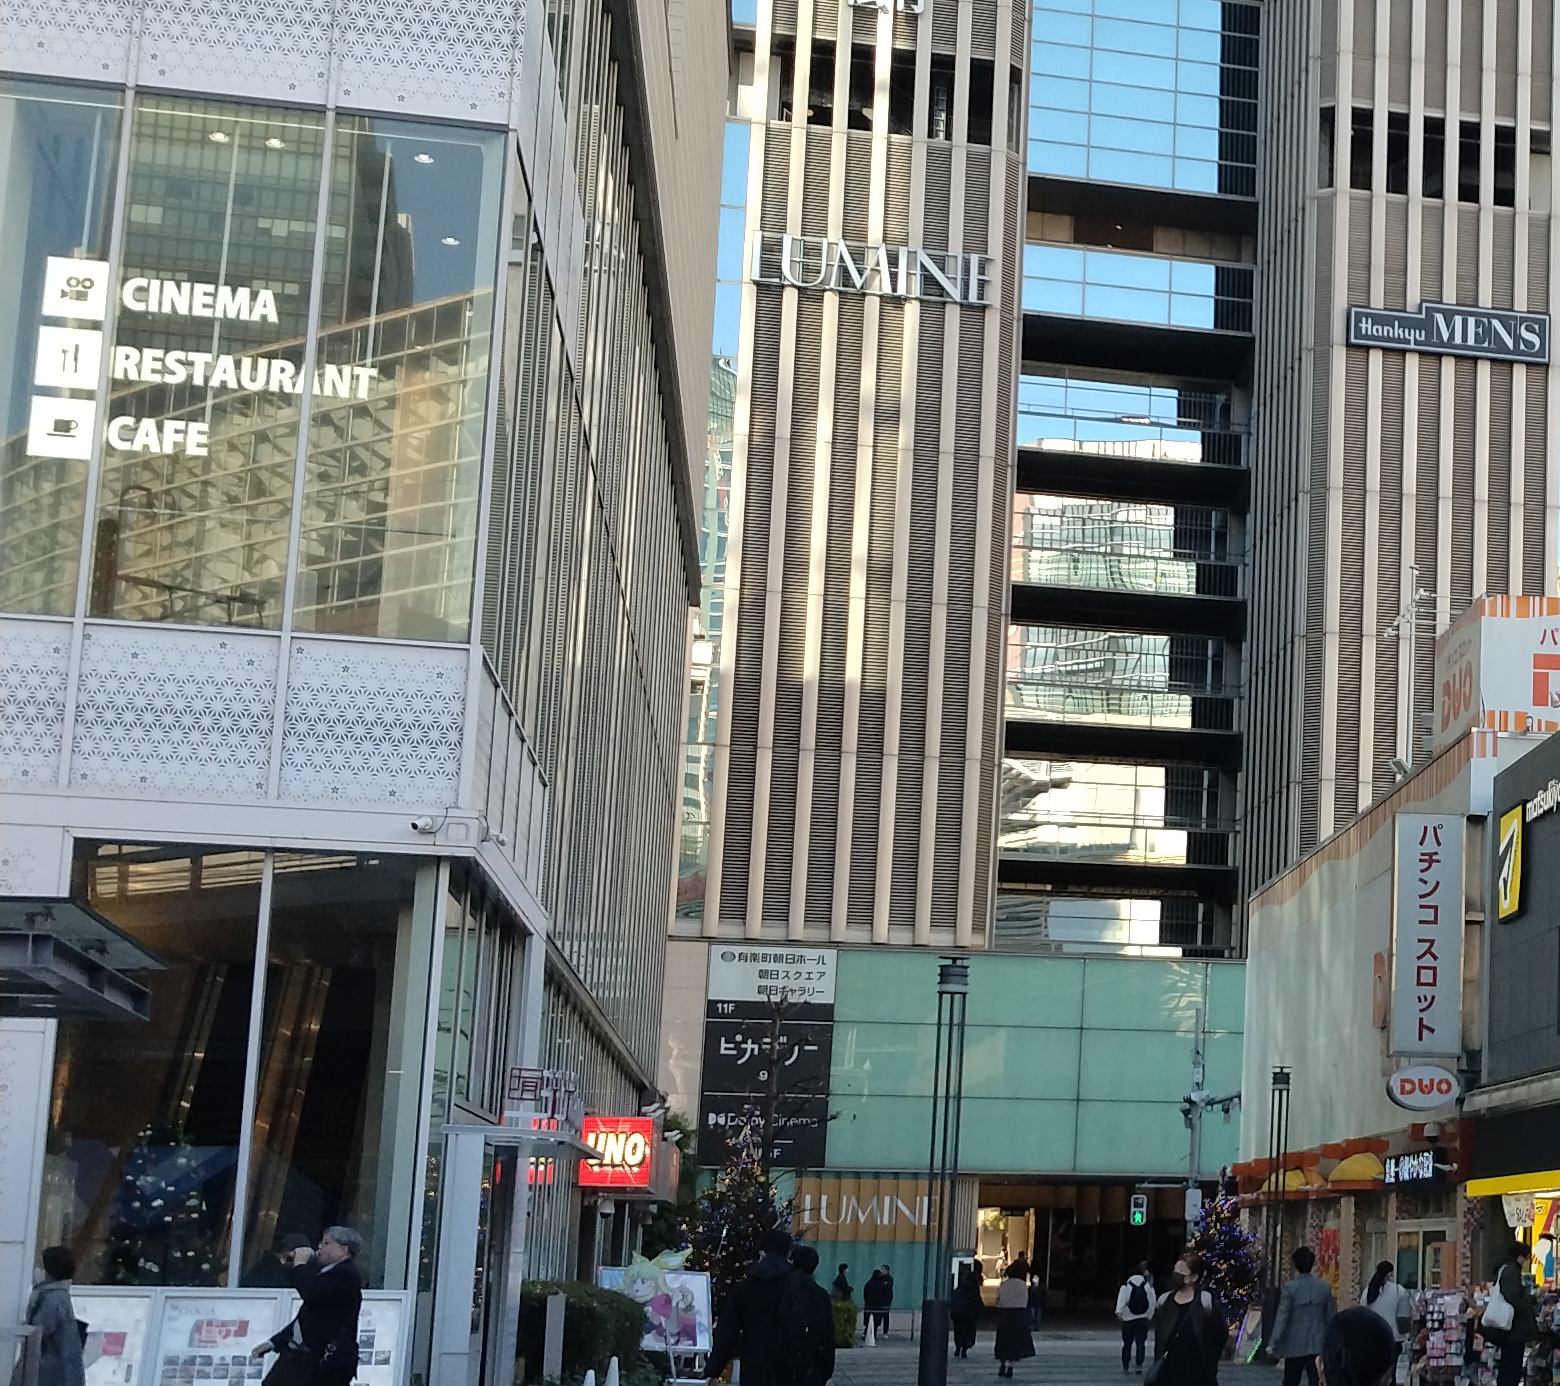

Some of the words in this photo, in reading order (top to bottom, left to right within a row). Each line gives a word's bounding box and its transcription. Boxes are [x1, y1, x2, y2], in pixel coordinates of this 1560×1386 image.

[751, 230, 993, 306] LUMINE
[122, 277, 279, 324] CINEMA
[1358, 316, 1426, 346] Hankyu
[114, 345, 378, 400] RESTAURANT
[108, 416, 209, 457] CAFE
[1418, 823, 1443, 926] パチンコ
[757, 969, 826, 981] 朝日スクエア
[1415, 938, 1440, 1042] スロット
[716, 1003, 736, 1014] 11F
[1400, 1078, 1452, 1096] DUO
